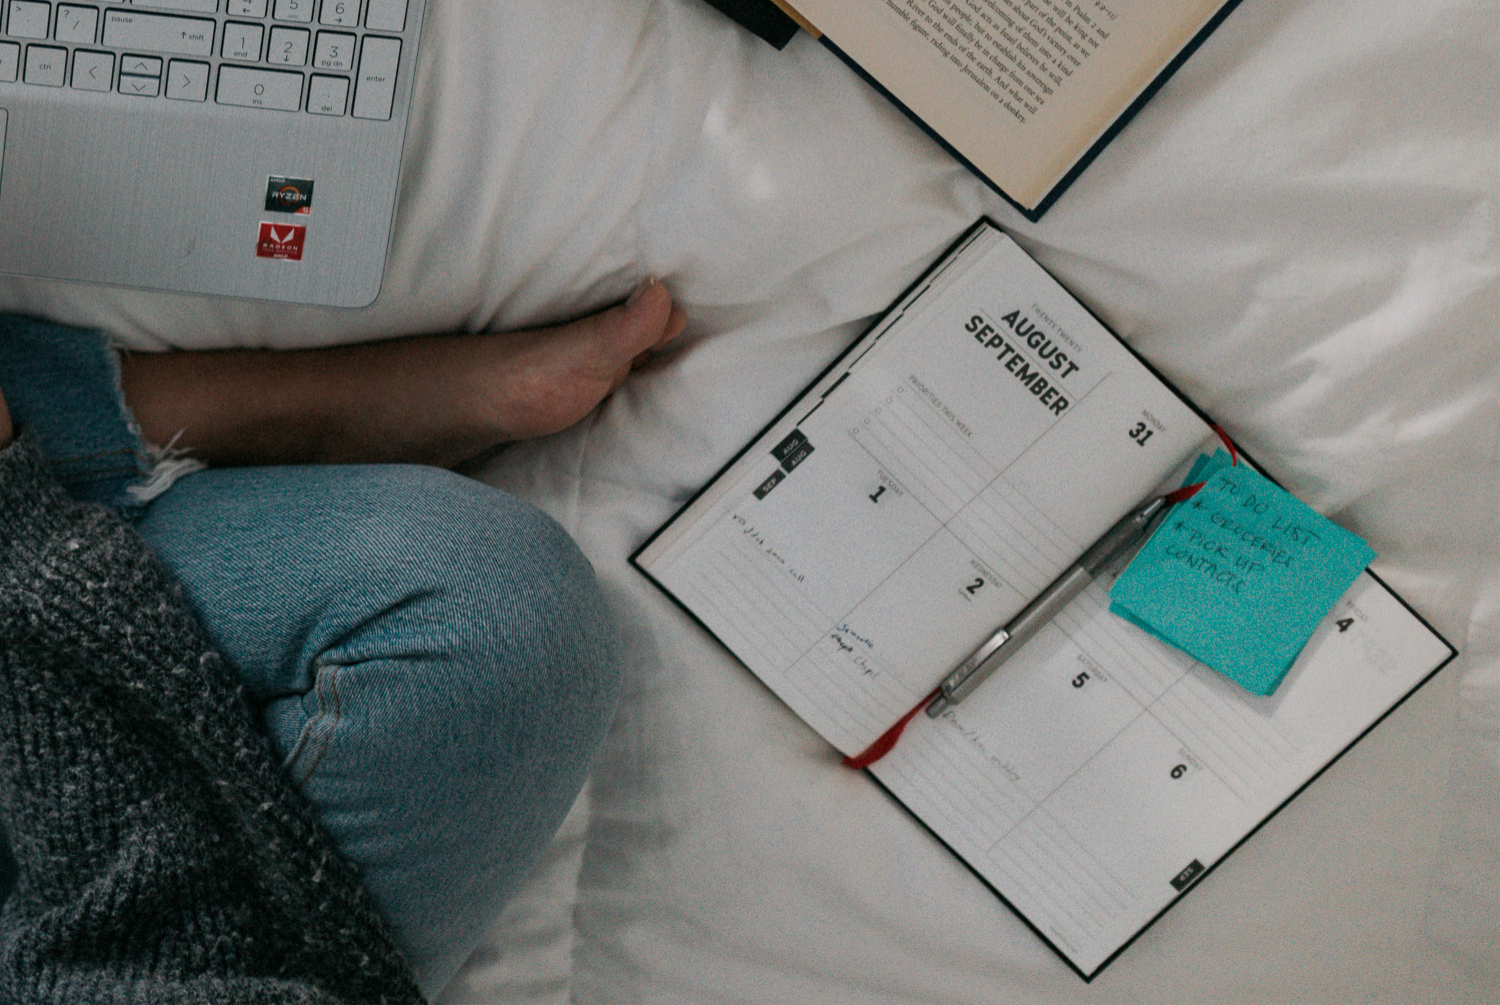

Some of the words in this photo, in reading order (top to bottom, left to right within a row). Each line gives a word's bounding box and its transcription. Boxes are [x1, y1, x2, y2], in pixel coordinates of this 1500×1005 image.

[272, 191, 307, 201] RYZEN
[263, 243, 298, 251] RADEON
[1030, 302, 1058, 330] TWENTY
[1056, 326, 1084, 354] TWENTY
[1000, 309, 1080, 379] AUGUST
[964, 314, 1070, 417] SEPTEMBER
[908, 373, 943, 408] PRIORITIES
[941, 405, 957, 423] THIS
[954, 419, 974, 439] WEEK
[1140, 408, 1167, 433] MONDAY
[783, 438, 799, 455] AUG
[1128, 421, 1154, 448] 31
[791, 450, 807, 467] AUG
[762, 477, 777, 493] SEP
[868, 485, 887, 504] 1
[876, 467, 905, 498] TUESDAY
[1218, 473, 1242, 497] TO
[1241, 493, 1269, 516] DO
[1271, 514, 1324, 548] LIST
[1190, 528, 1231, 560] PICK
[1234, 552, 1268, 578] UP
[1212, 513, 1295, 569] GROCERIES
[969, 557, 1004, 589] WEDNESDAY
[1164, 544, 1246, 596] CONTACTS
[965, 577, 985, 596] 2
[1335, 617, 1355, 634] 4
[1071, 671, 1091, 689] 5
[1075, 652, 1109, 683] SATURDAY
[1169, 763, 1188, 780] 6
[1176, 747, 1206, 773] SUNDAY
